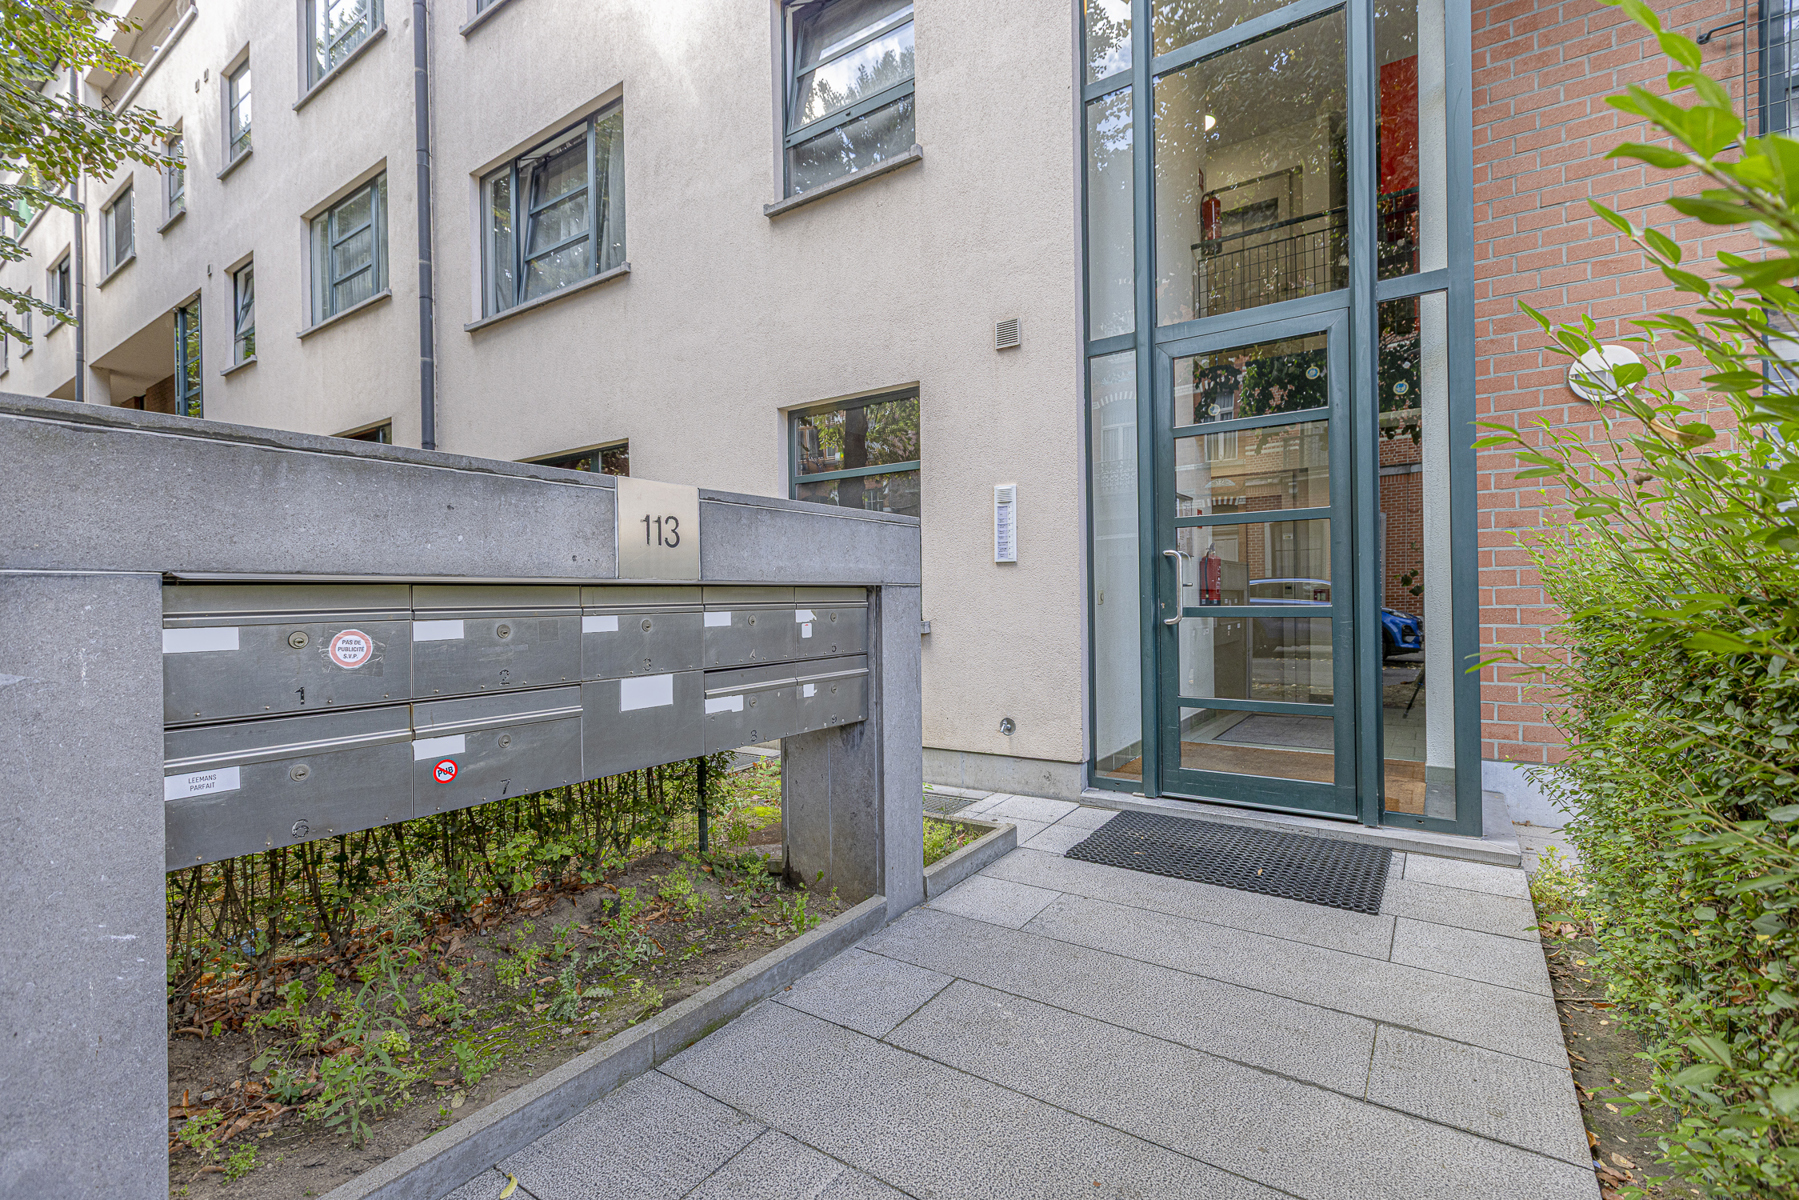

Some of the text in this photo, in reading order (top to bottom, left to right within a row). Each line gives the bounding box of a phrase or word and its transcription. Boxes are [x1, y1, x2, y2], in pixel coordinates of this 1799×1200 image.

[641, 514, 680, 549] 113
[749, 649, 757, 660] 4
[642, 658, 652, 672] 3
[499, 669, 510, 686] 2
[294, 687, 305, 705] 1
[188, 774, 217, 784] LEEMANS
[437, 766, 454, 777] PUB
[189, 782, 216, 792] PARFAIT
[500, 779, 511, 795] 7
[291, 818, 310, 839] 6
